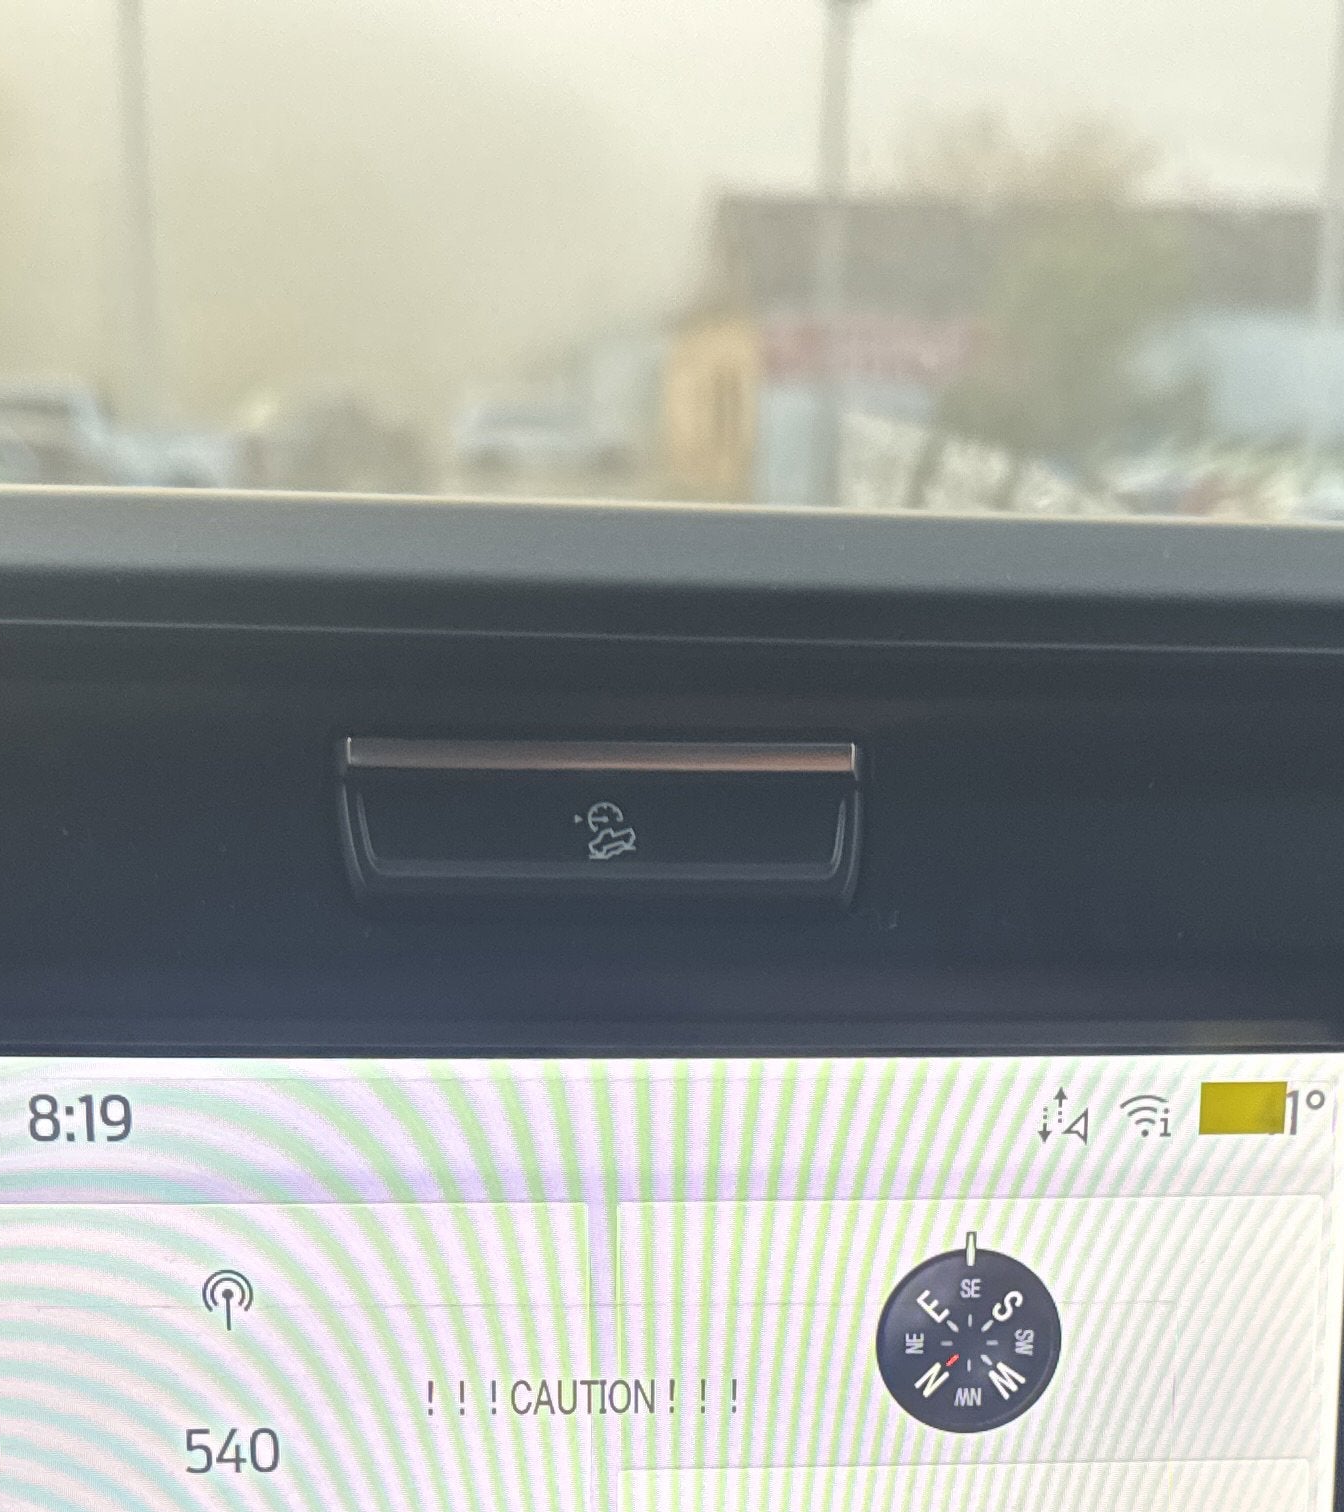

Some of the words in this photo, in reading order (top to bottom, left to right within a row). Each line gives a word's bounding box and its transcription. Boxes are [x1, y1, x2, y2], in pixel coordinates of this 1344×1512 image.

[27, 1093, 133, 1143] 8:19
[960, 1278, 983, 1299] SE
[991, 1290, 1024, 1322] S
[916, 1289, 950, 1324] E
[904, 1332, 925, 1355] NE
[1014, 1328, 1035, 1356] SW
[913, 1361, 950, 1398] N
[988, 1361, 1026, 1400] W
[185, 1426, 281, 1475] 540
